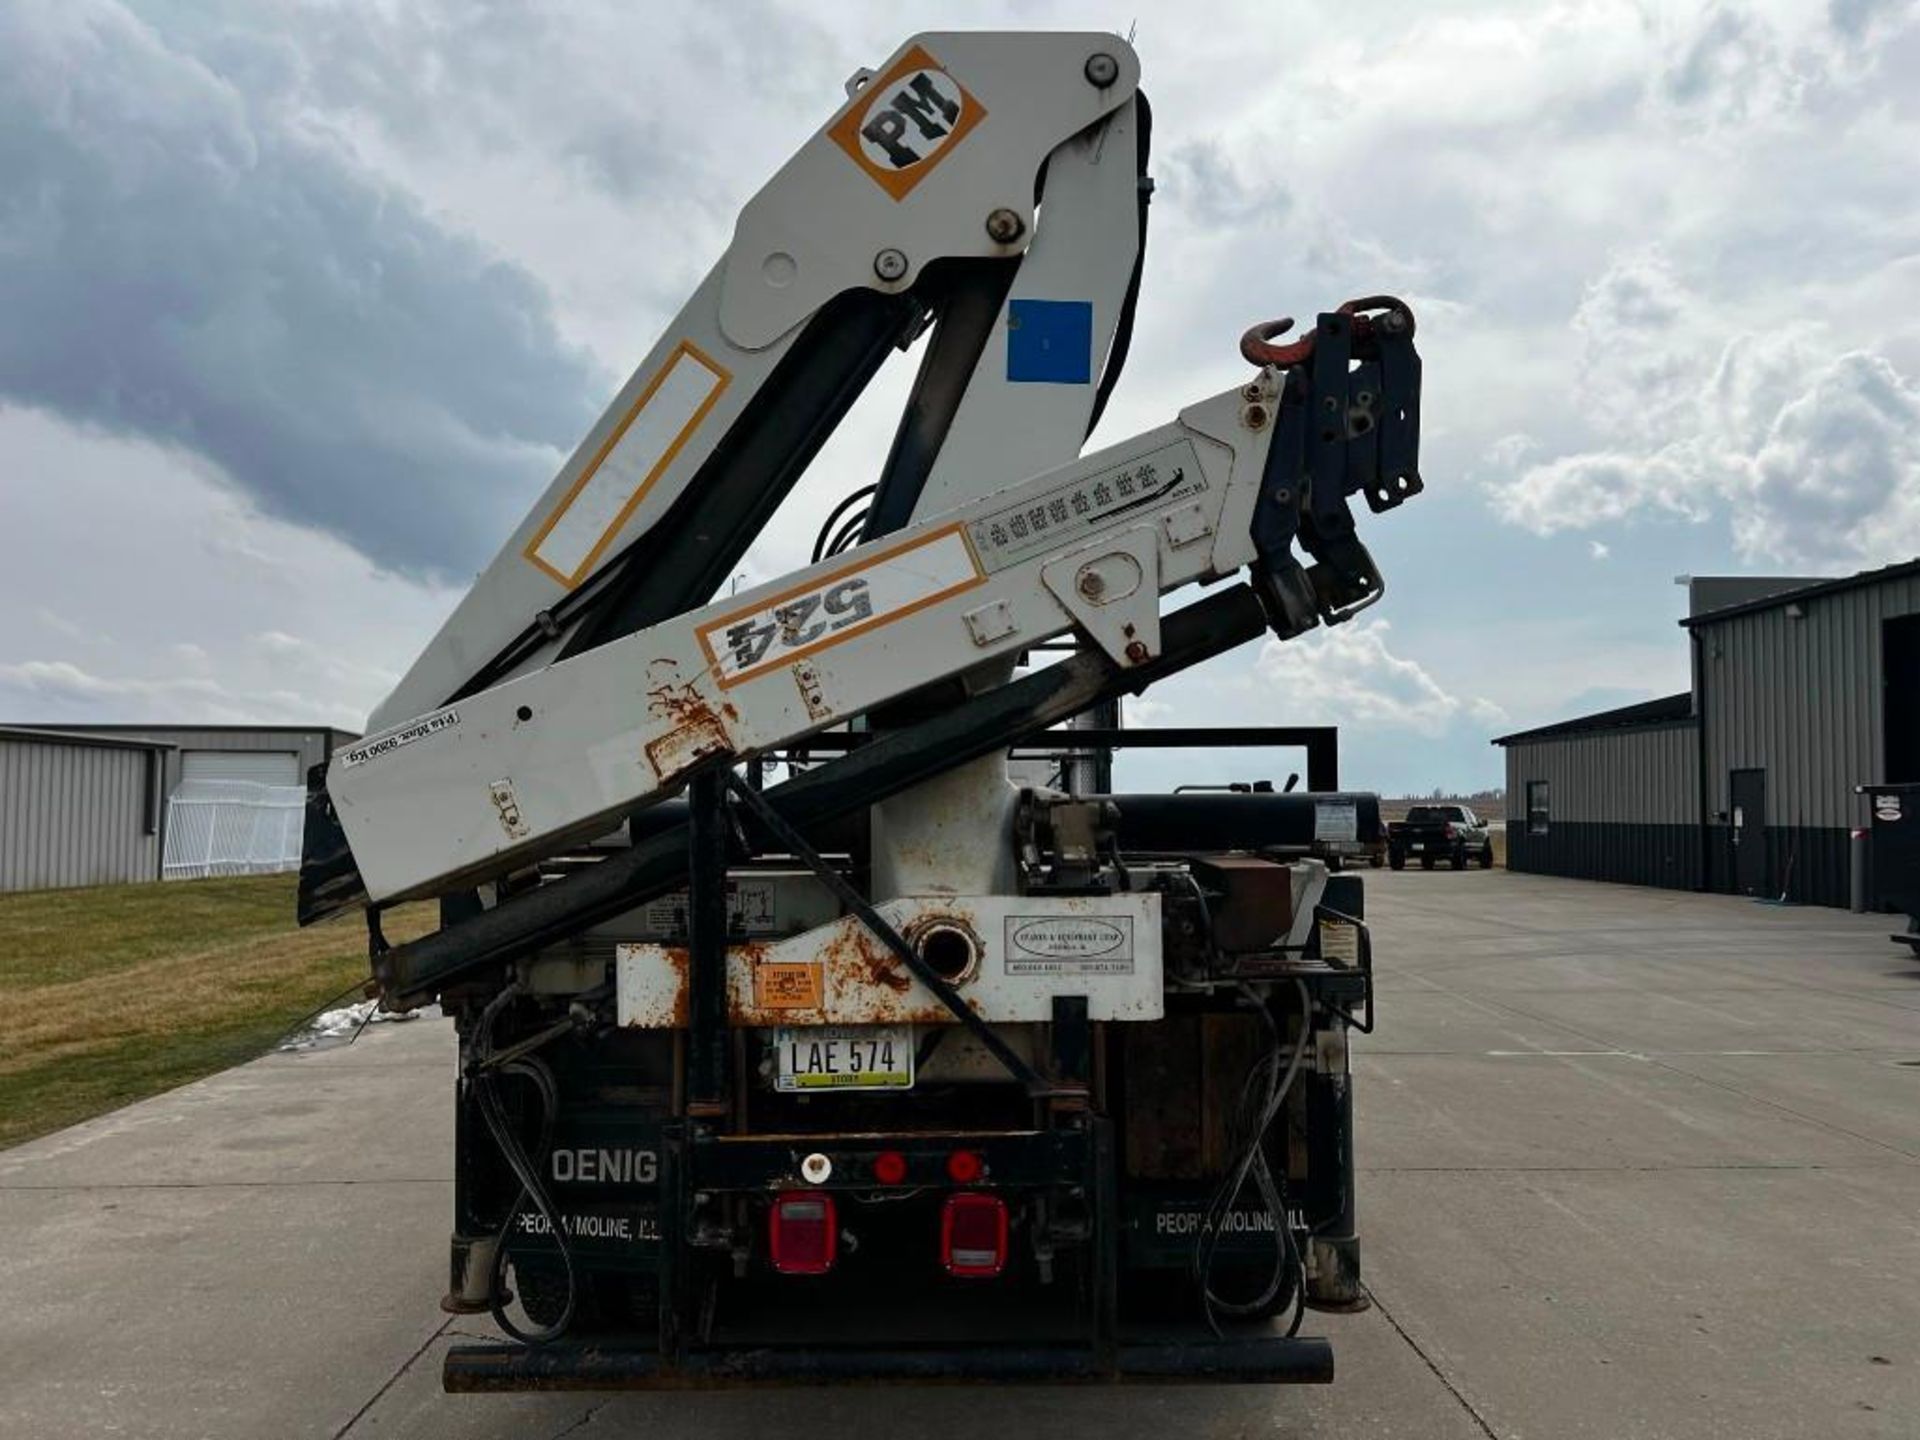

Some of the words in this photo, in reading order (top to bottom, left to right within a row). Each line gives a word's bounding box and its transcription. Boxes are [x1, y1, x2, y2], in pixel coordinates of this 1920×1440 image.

[861, 72, 960, 168] PM
[726, 578, 874, 669] 524
[792, 1041, 839, 1074] LAE
[849, 1041, 895, 1073] 574
[552, 1149, 657, 1183] OENIG
